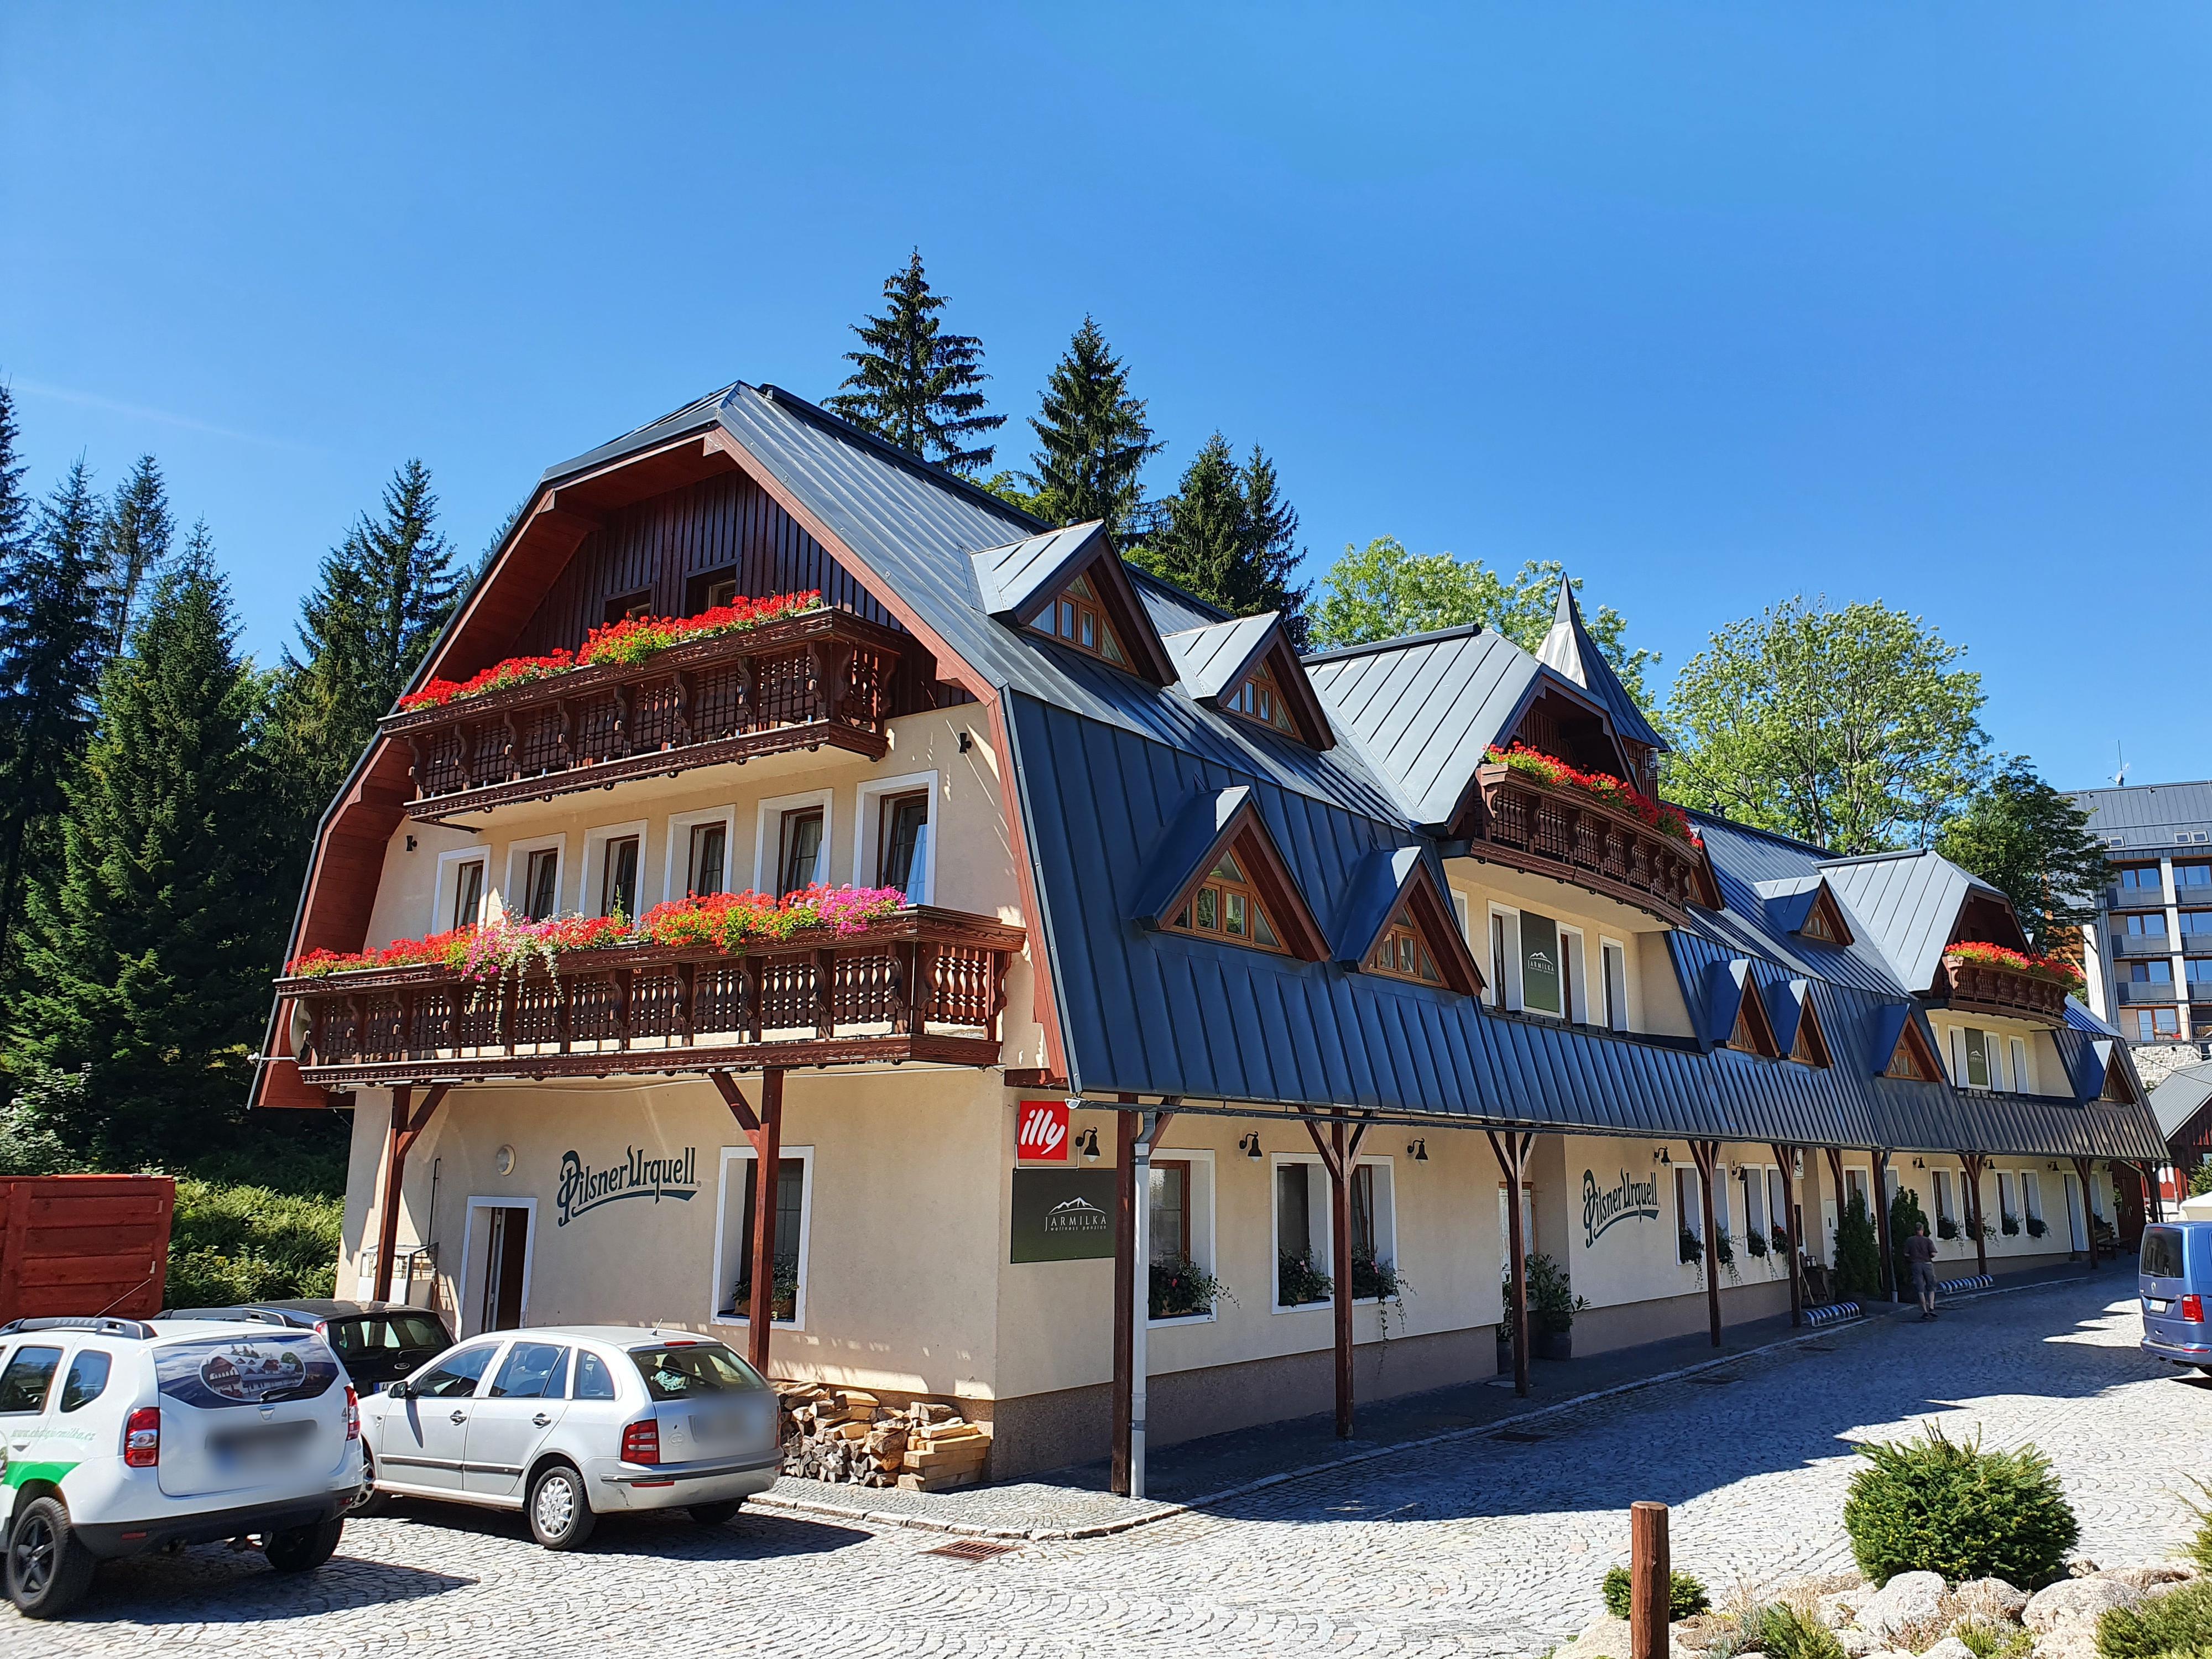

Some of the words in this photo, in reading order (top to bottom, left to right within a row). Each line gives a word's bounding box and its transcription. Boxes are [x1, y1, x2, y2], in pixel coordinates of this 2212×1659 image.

[1527, 959, 1554, 972] JARMILKA
[1020, 1108, 1066, 1155] illy
[557, 1150, 628, 1227] Pilsner
[627, 1145, 696, 1205] Urquell
[1583, 1168, 1623, 1249] Pilsner
[1620, 1167, 1658, 1223] Urquell
[1045, 1215, 1107, 1232] JARMILKA
